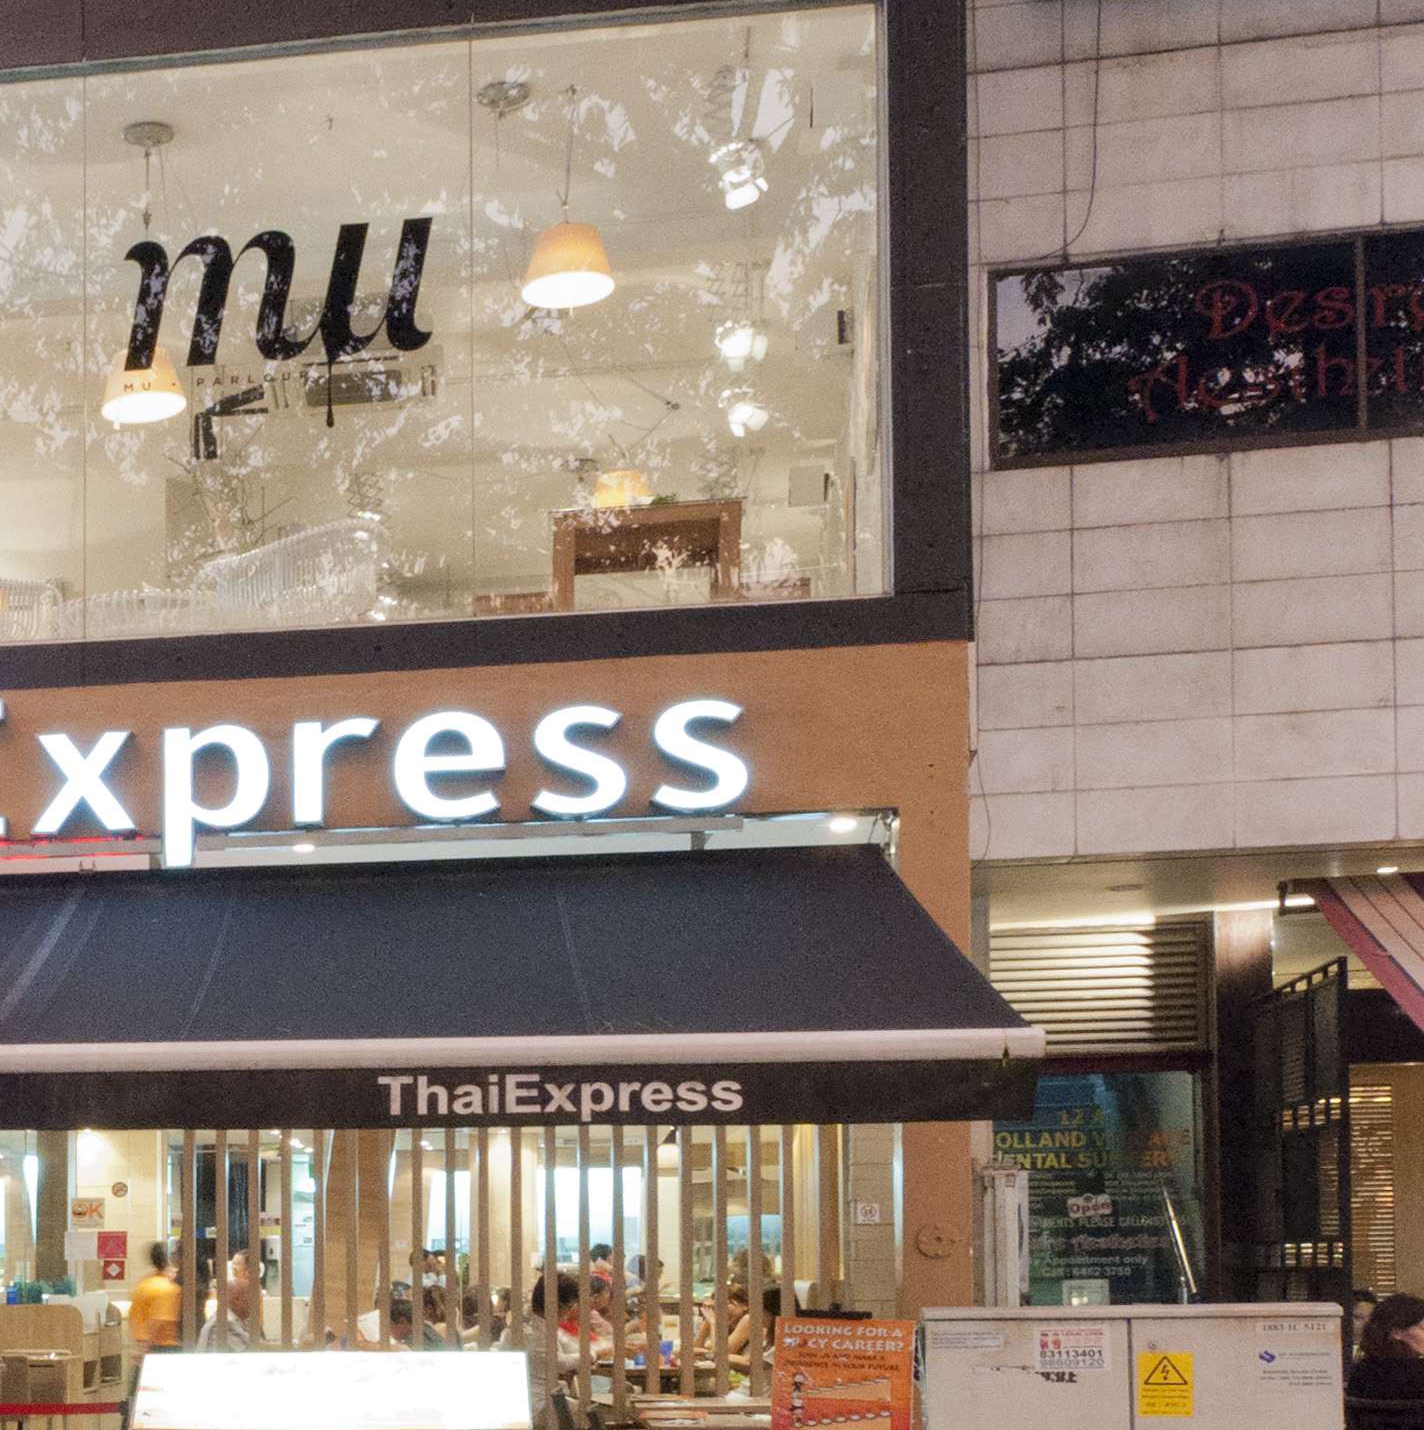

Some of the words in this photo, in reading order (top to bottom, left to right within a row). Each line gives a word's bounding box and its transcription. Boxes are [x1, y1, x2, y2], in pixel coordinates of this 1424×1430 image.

[123, 217, 433, 428] mu
[124, 382, 152, 392] MU
[377, 1073, 744, 1122] ThaiExpress
[993, 1130, 1087, 1148] OLLAND
[784, 1323, 853, 1336] LOOKING
[857, 1327, 888, 1337] FOR
[891, 1328, 904, 1338] A
[832, 1338, 904, 1352] CAREER?
[1039, 1349, 1103, 1358] 83113401
